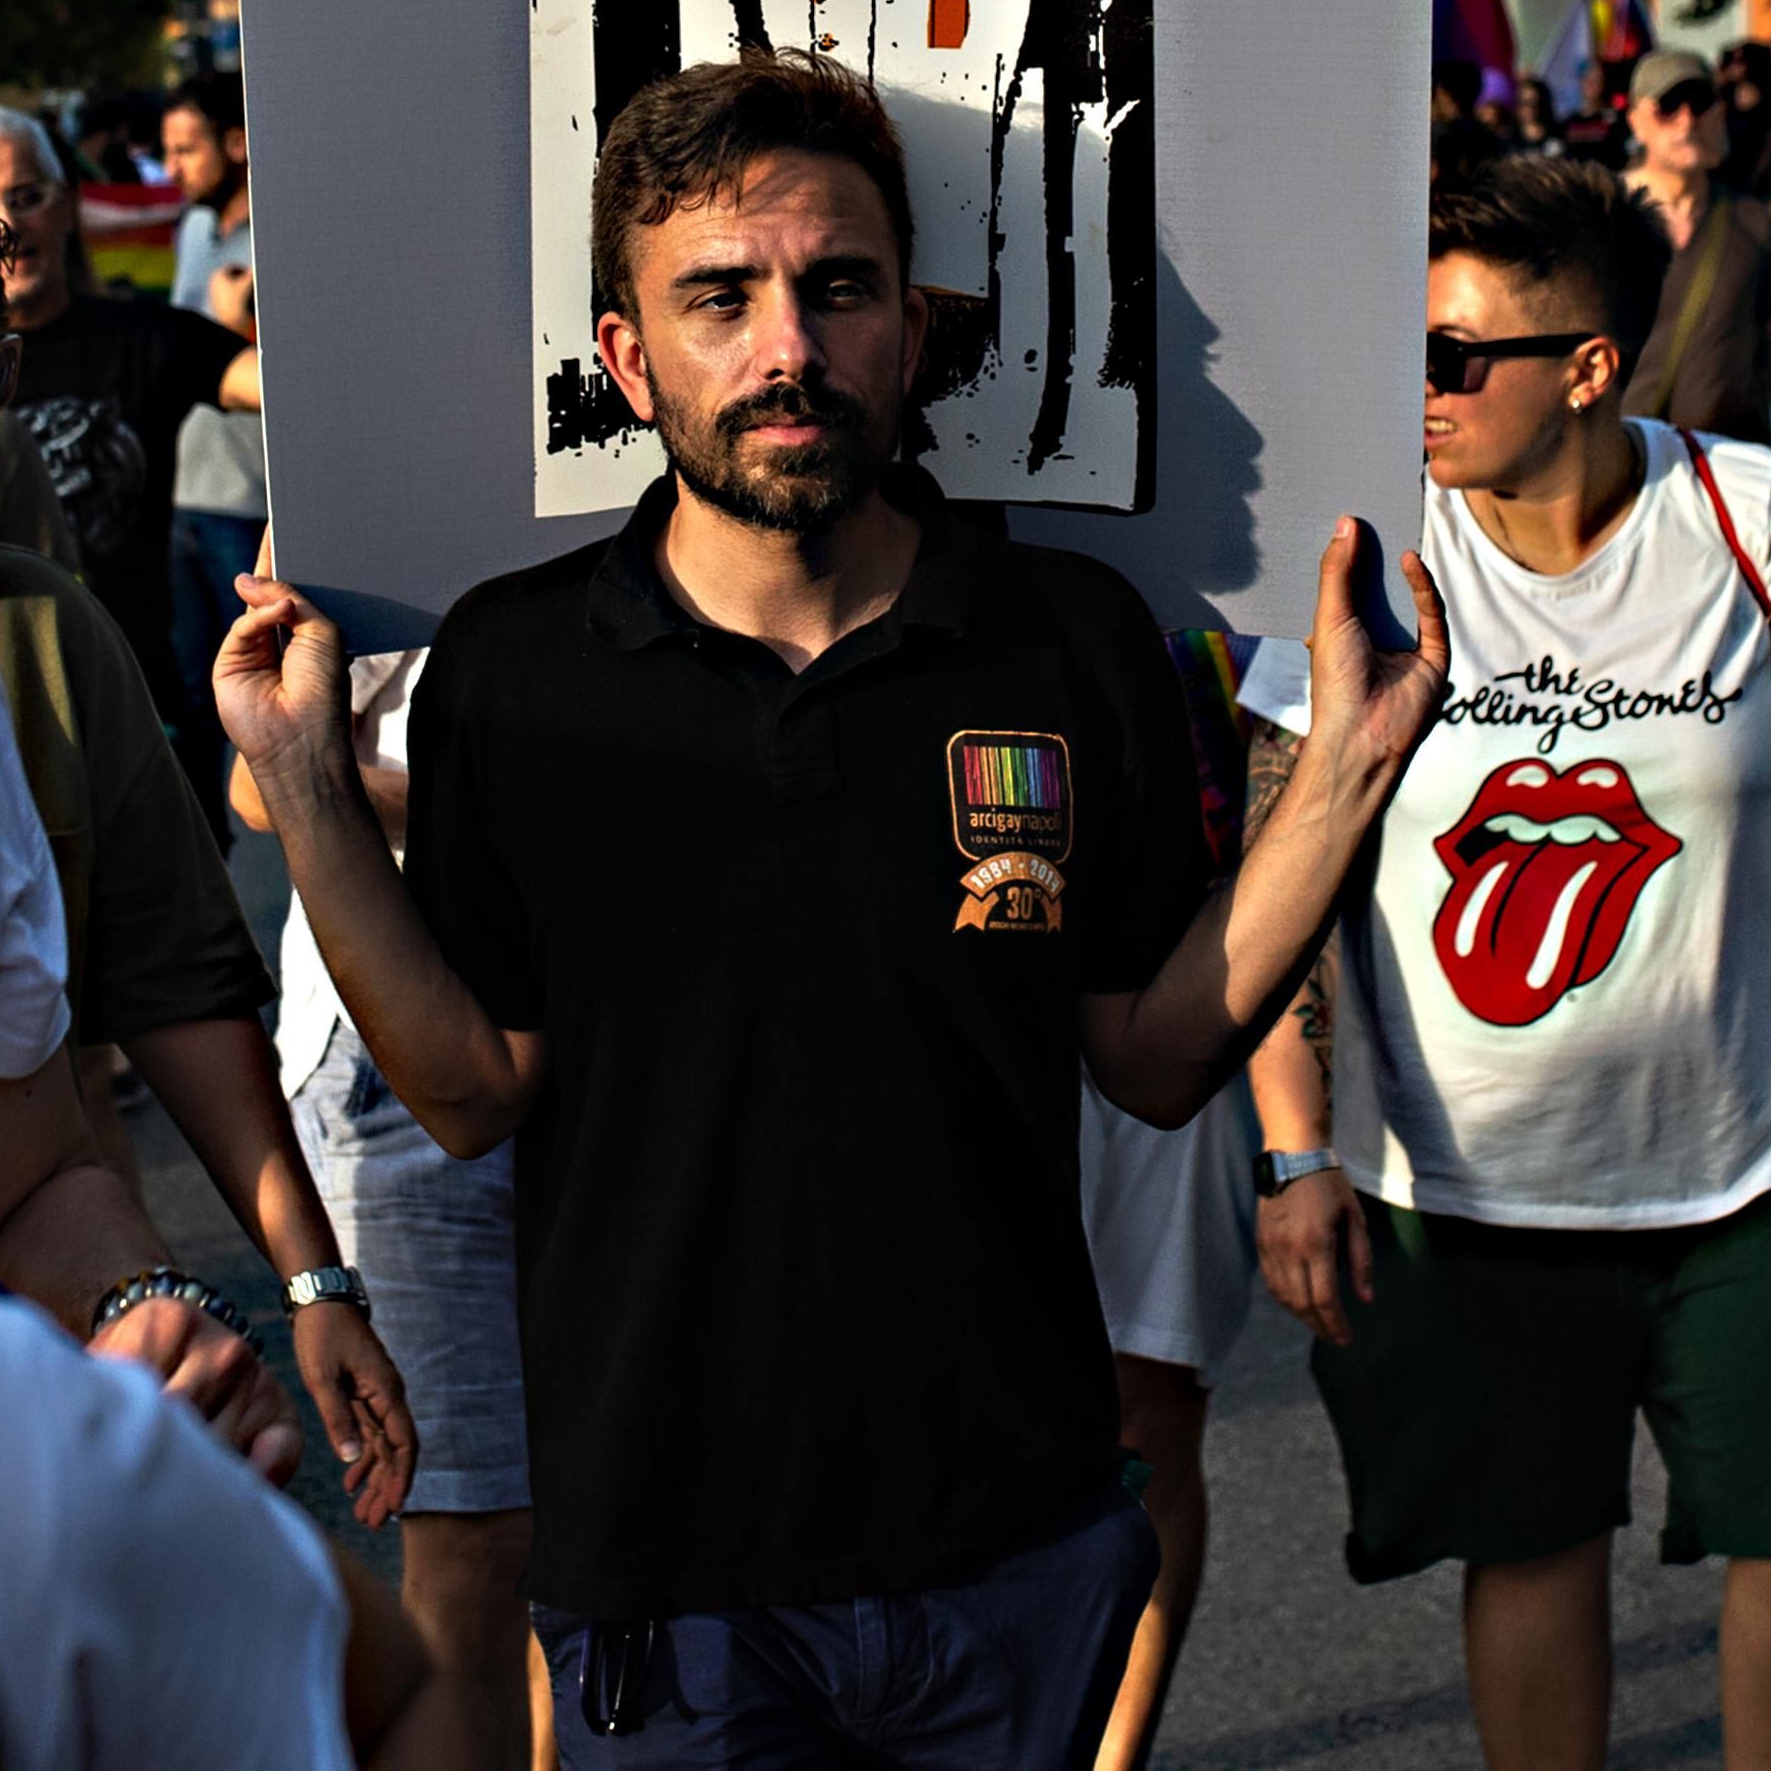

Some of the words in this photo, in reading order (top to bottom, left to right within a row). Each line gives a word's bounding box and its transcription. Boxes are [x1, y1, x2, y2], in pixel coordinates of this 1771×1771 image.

[1494, 655, 1585, 696] the
[1572, 670, 1743, 731] Stones
[969, 858, 1012, 889] 1984
